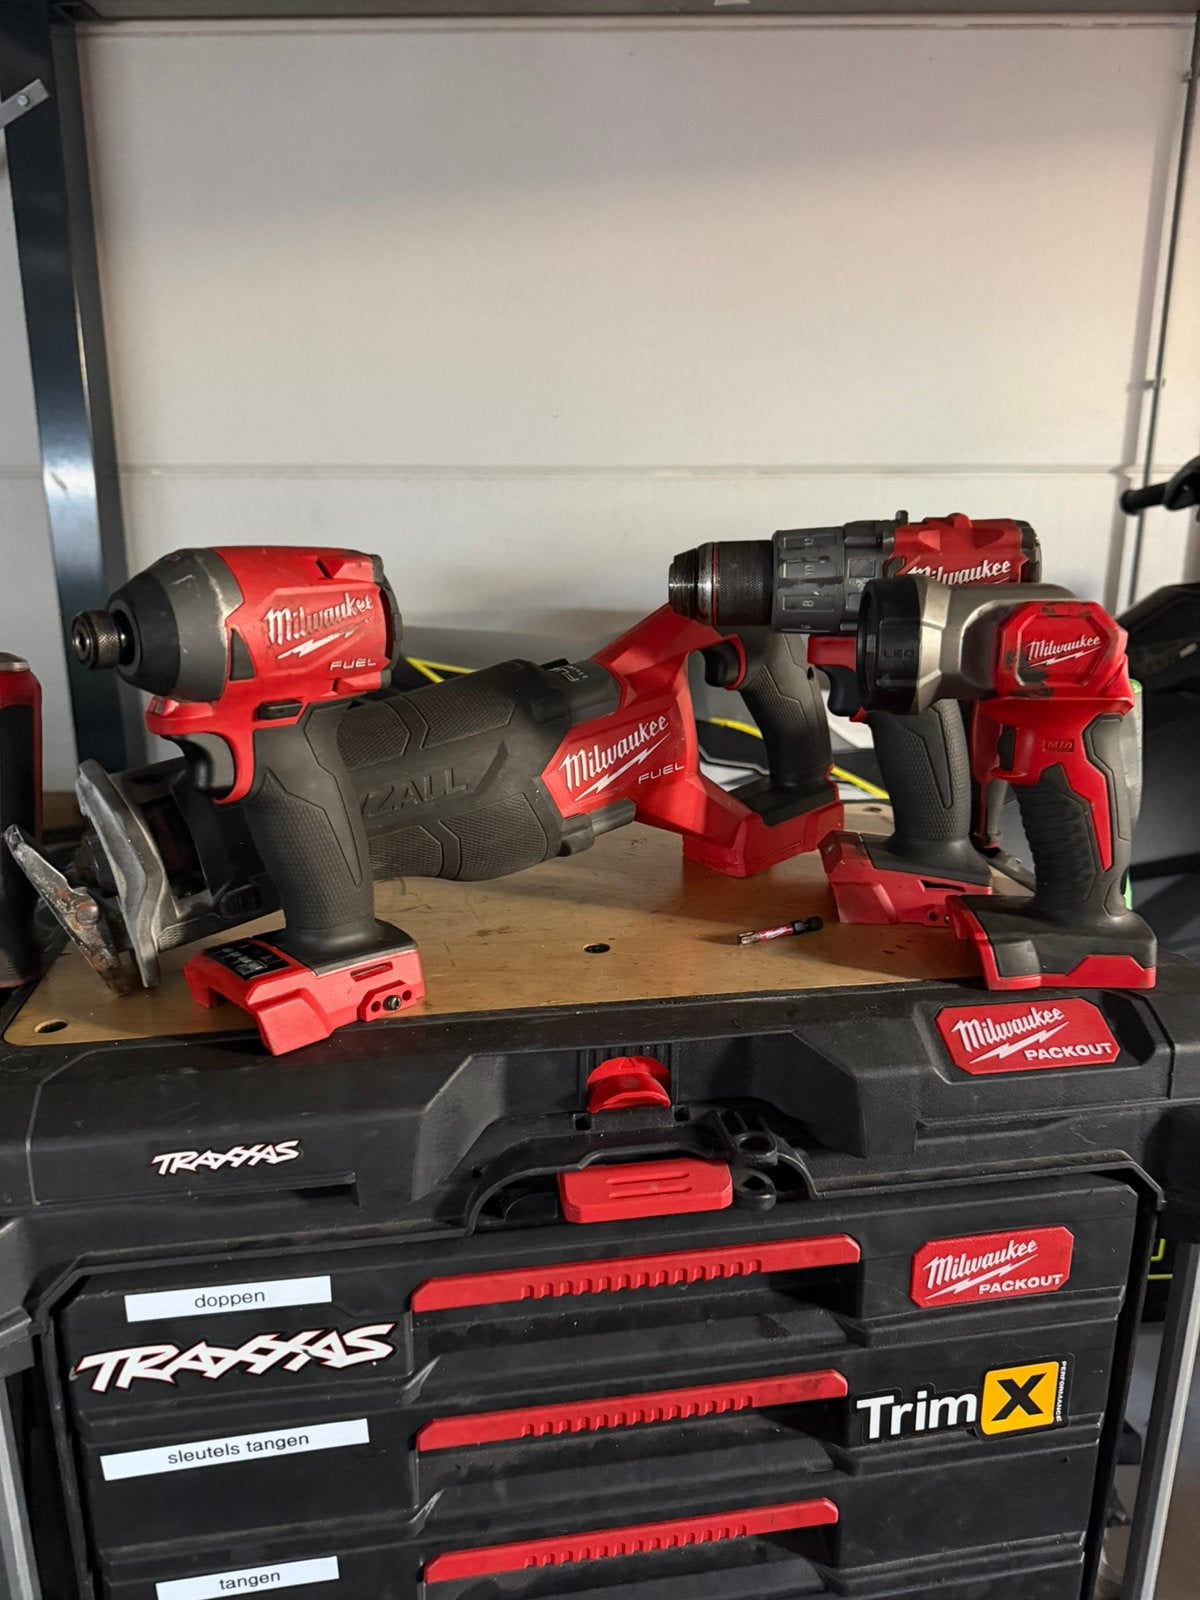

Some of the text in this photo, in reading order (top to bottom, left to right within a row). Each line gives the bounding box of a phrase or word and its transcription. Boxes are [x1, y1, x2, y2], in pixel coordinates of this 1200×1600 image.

[1026, 633, 1101, 661] Milwaukee
[329, 657, 377, 672] FUEL
[558, 715, 670, 793] Milwaukee
[638, 762, 685, 785] FUEL
[951, 1006, 1065, 1053] Milwaukee
[1024, 1042, 1112, 1062] PACKOUT
[152, 1140, 300, 1175] TRAXXAS
[922, 1239, 1039, 1290] Milwaukee
[194, 1289, 266, 1309] doppen
[979, 1273, 1064, 1296] PACKOUT
[75, 1322, 397, 1393] TRAXXAS
[1055, 1360, 1068, 1423] PERFORMANCE
[167, 1434, 310, 1465] sleutels tangen
[218, 1572, 281, 1591] tangen
